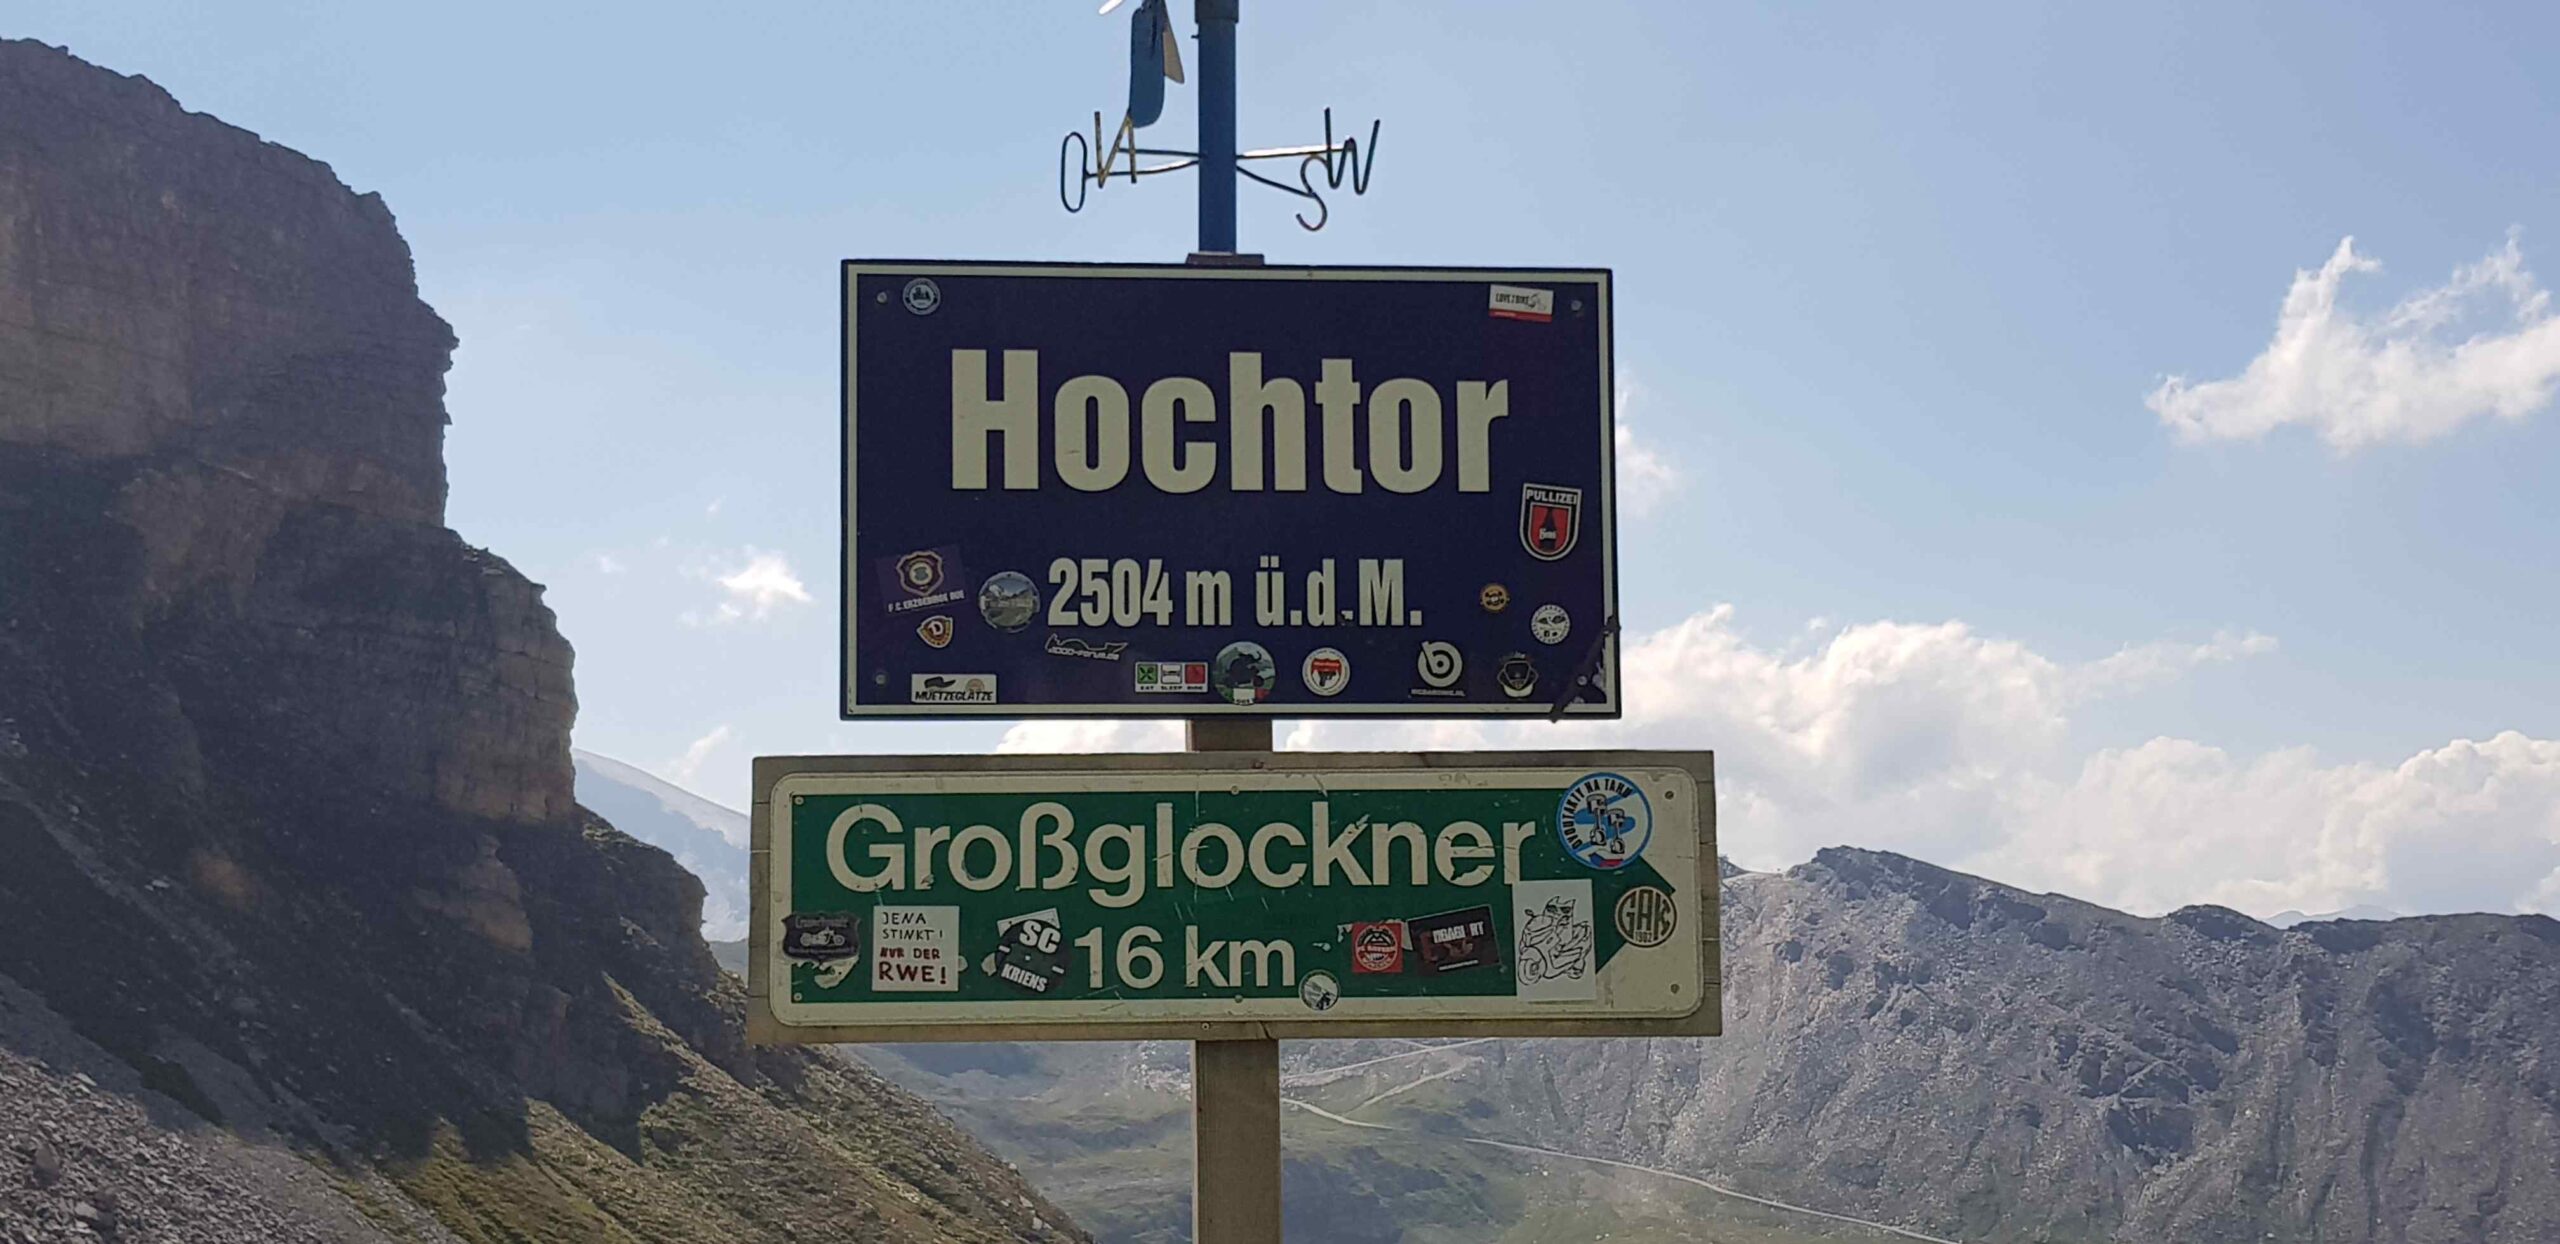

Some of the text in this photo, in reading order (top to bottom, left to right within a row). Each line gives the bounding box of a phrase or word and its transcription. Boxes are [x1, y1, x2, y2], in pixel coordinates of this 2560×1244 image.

[951, 348, 1509, 494] Hochtor
[1526, 488, 1578, 505] PULLIZEI
[1047, 555, 1422, 627] 2504 m ü.d.M.
[915, 690, 994, 701] MUETZEGLATZE
[1587, 779, 1601, 793] NA
[826, 801, 1537, 908] Großglockner
[882, 911, 927, 925] JENA
[1019, 920, 1062, 954] SC
[880, 946, 941, 960] NUR DER
[1074, 925, 1296, 989] 16 km
[878, 961, 947, 985] RWE!
[1001, 963, 1048, 992] KRIENS
